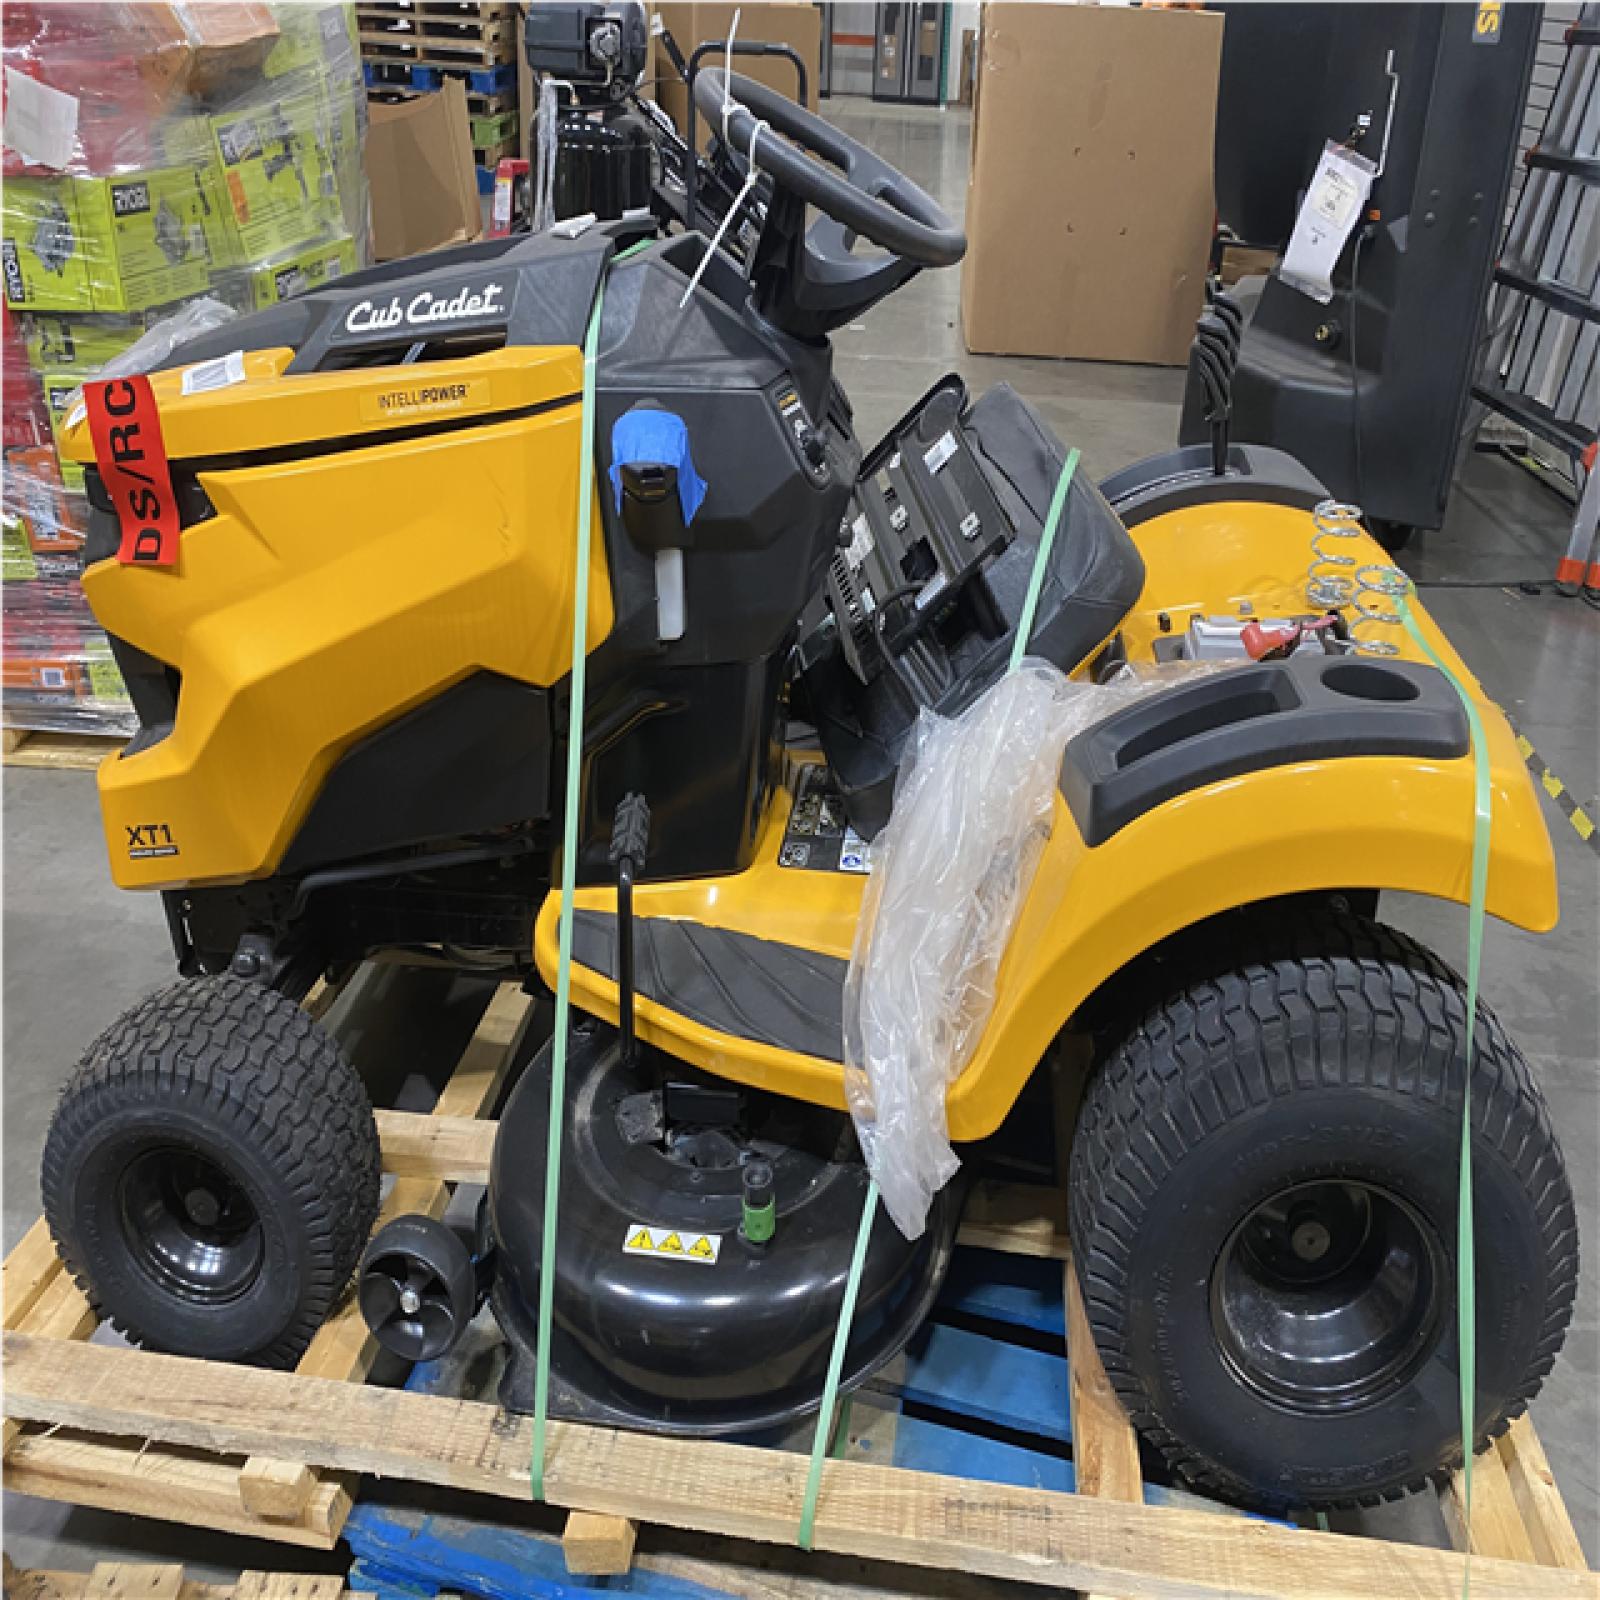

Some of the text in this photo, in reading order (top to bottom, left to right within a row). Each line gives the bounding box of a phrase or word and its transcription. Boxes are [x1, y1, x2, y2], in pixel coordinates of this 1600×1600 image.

[347, 283, 503, 331] Cub Cadet
[378, 384, 467, 408] INTELLIPOWER
[104, 380, 161, 561] DS/RC
[125, 824, 172, 846] XT1
